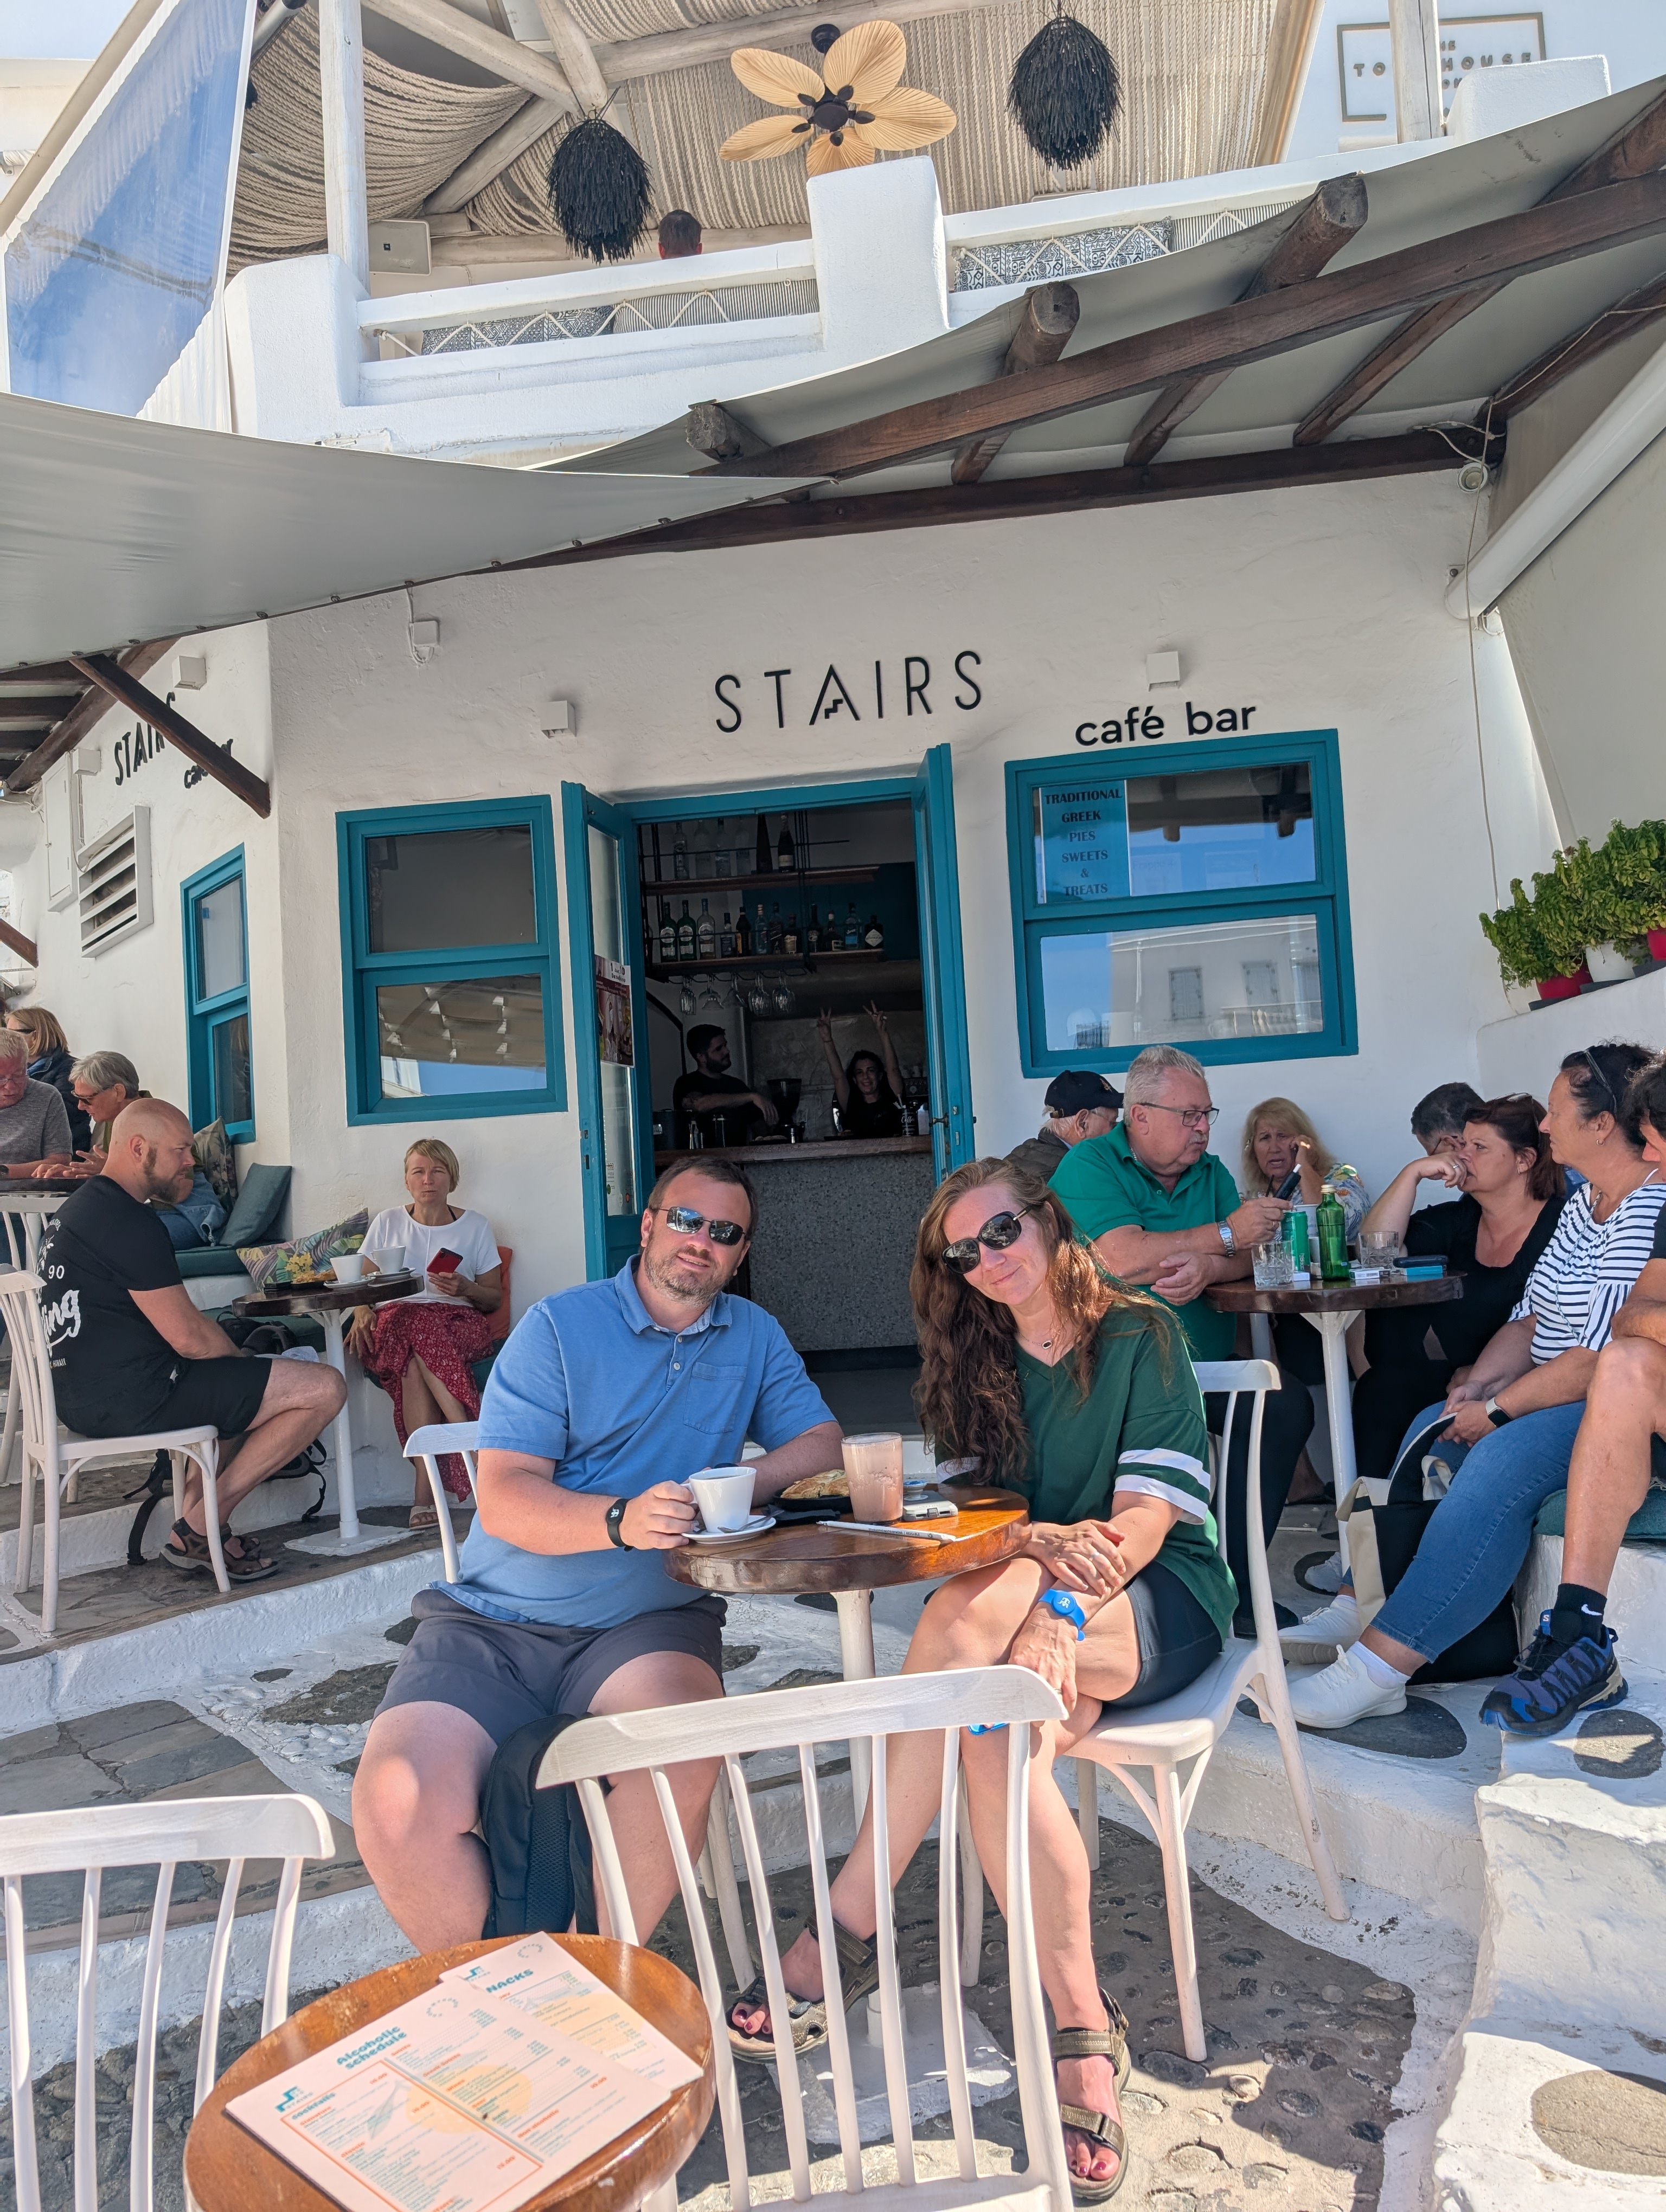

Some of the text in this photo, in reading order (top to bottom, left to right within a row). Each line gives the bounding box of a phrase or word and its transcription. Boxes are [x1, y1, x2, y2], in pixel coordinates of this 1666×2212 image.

[1353, 52, 1532, 77] TOHOUSE
[715, 651, 982, 733] STAIRS
[1075, 702, 1257, 746] café bar
[1045, 789, 1122, 805] TRADITIONAL
[1061, 811, 1101, 823] GREEK
[1069, 831, 1095, 842] PIES
[1061, 850, 1108, 863] SWEETS
[1080, 869, 1089, 878] &
[1063, 884, 1108, 897] TREATS
[620, 966, 625, 975] 10
[48, 1265, 65, 1279] 90
[486, 1968, 533, 1993] NACKS
[336, 2025, 400, 2065] Alcoholic
[344, 2031, 406, 2069] schedule
